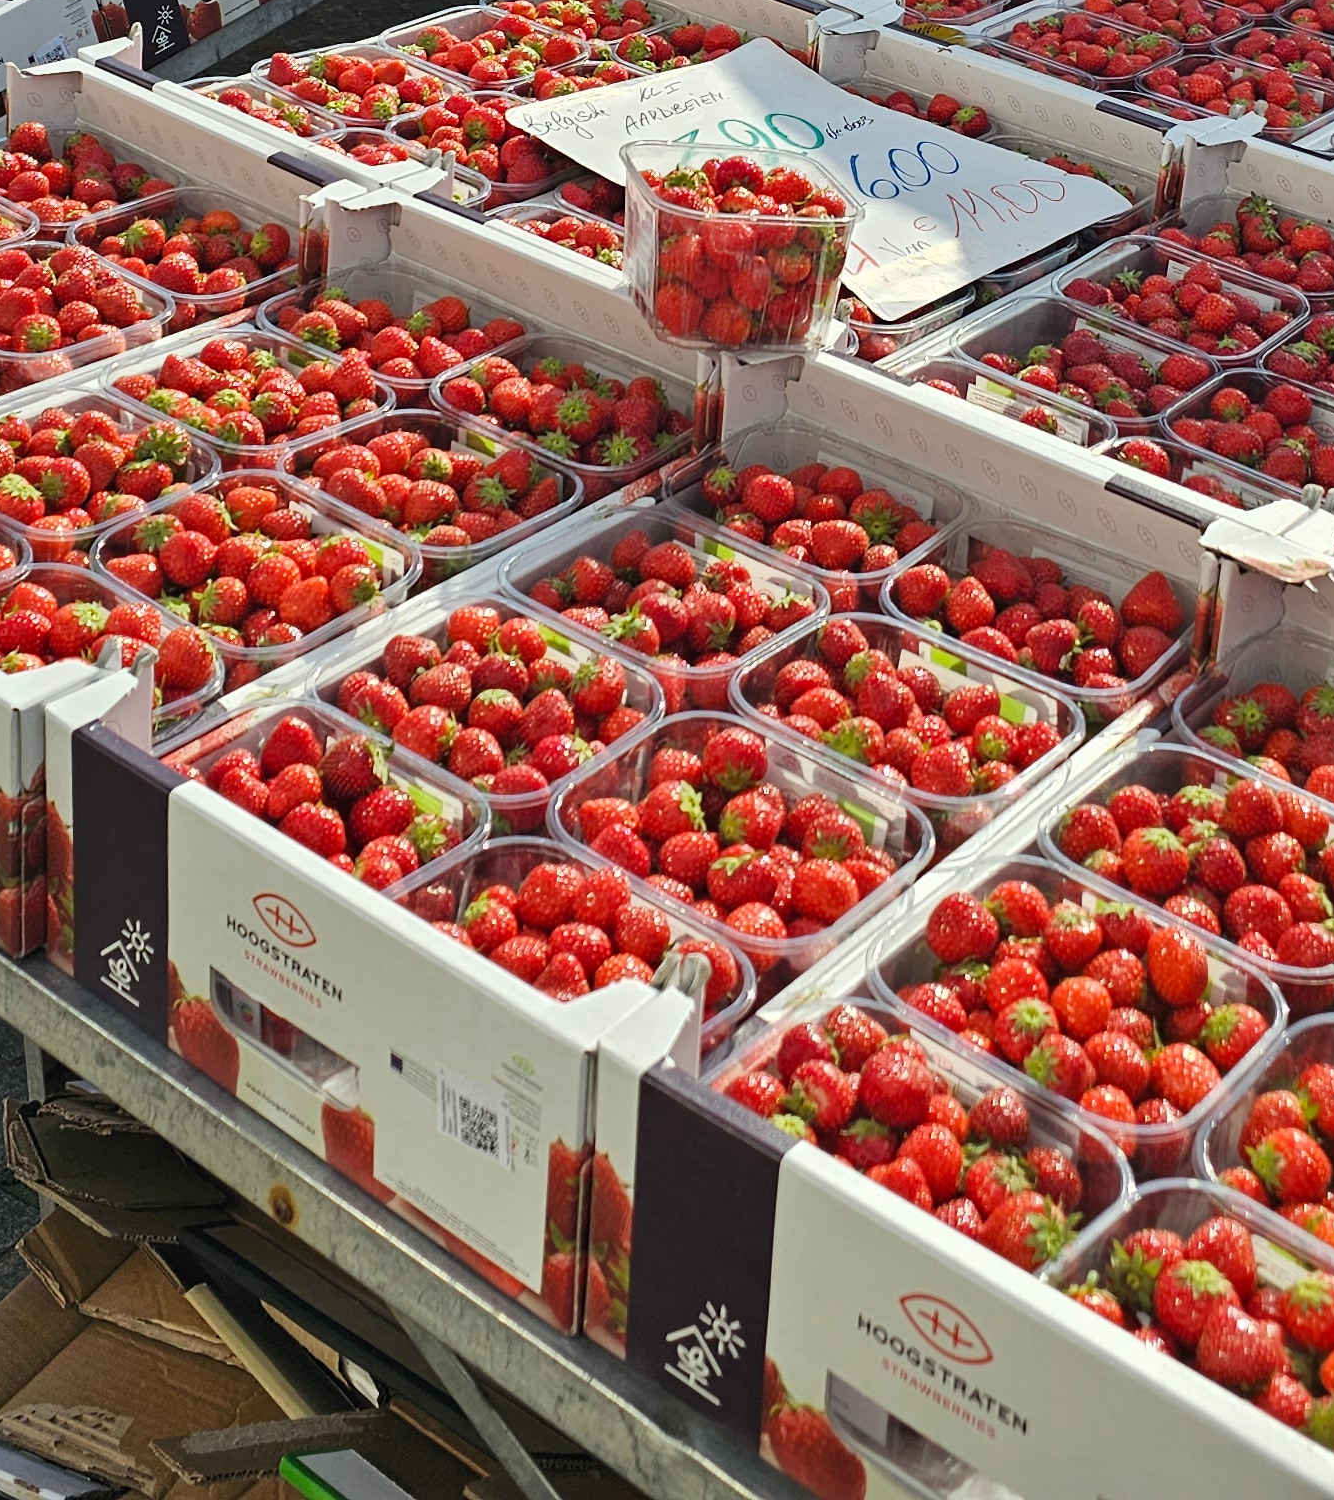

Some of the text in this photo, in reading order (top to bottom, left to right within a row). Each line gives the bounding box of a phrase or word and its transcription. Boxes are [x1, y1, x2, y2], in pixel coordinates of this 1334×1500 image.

[226, 913, 343, 1003] HOOGSTRATEN
[243, 949, 322, 1009] STRAWBERRIES
[857, 1312, 1028, 1436] HOOGSTRATEN
[881, 1356, 997, 1439] STRAWBERRIES
